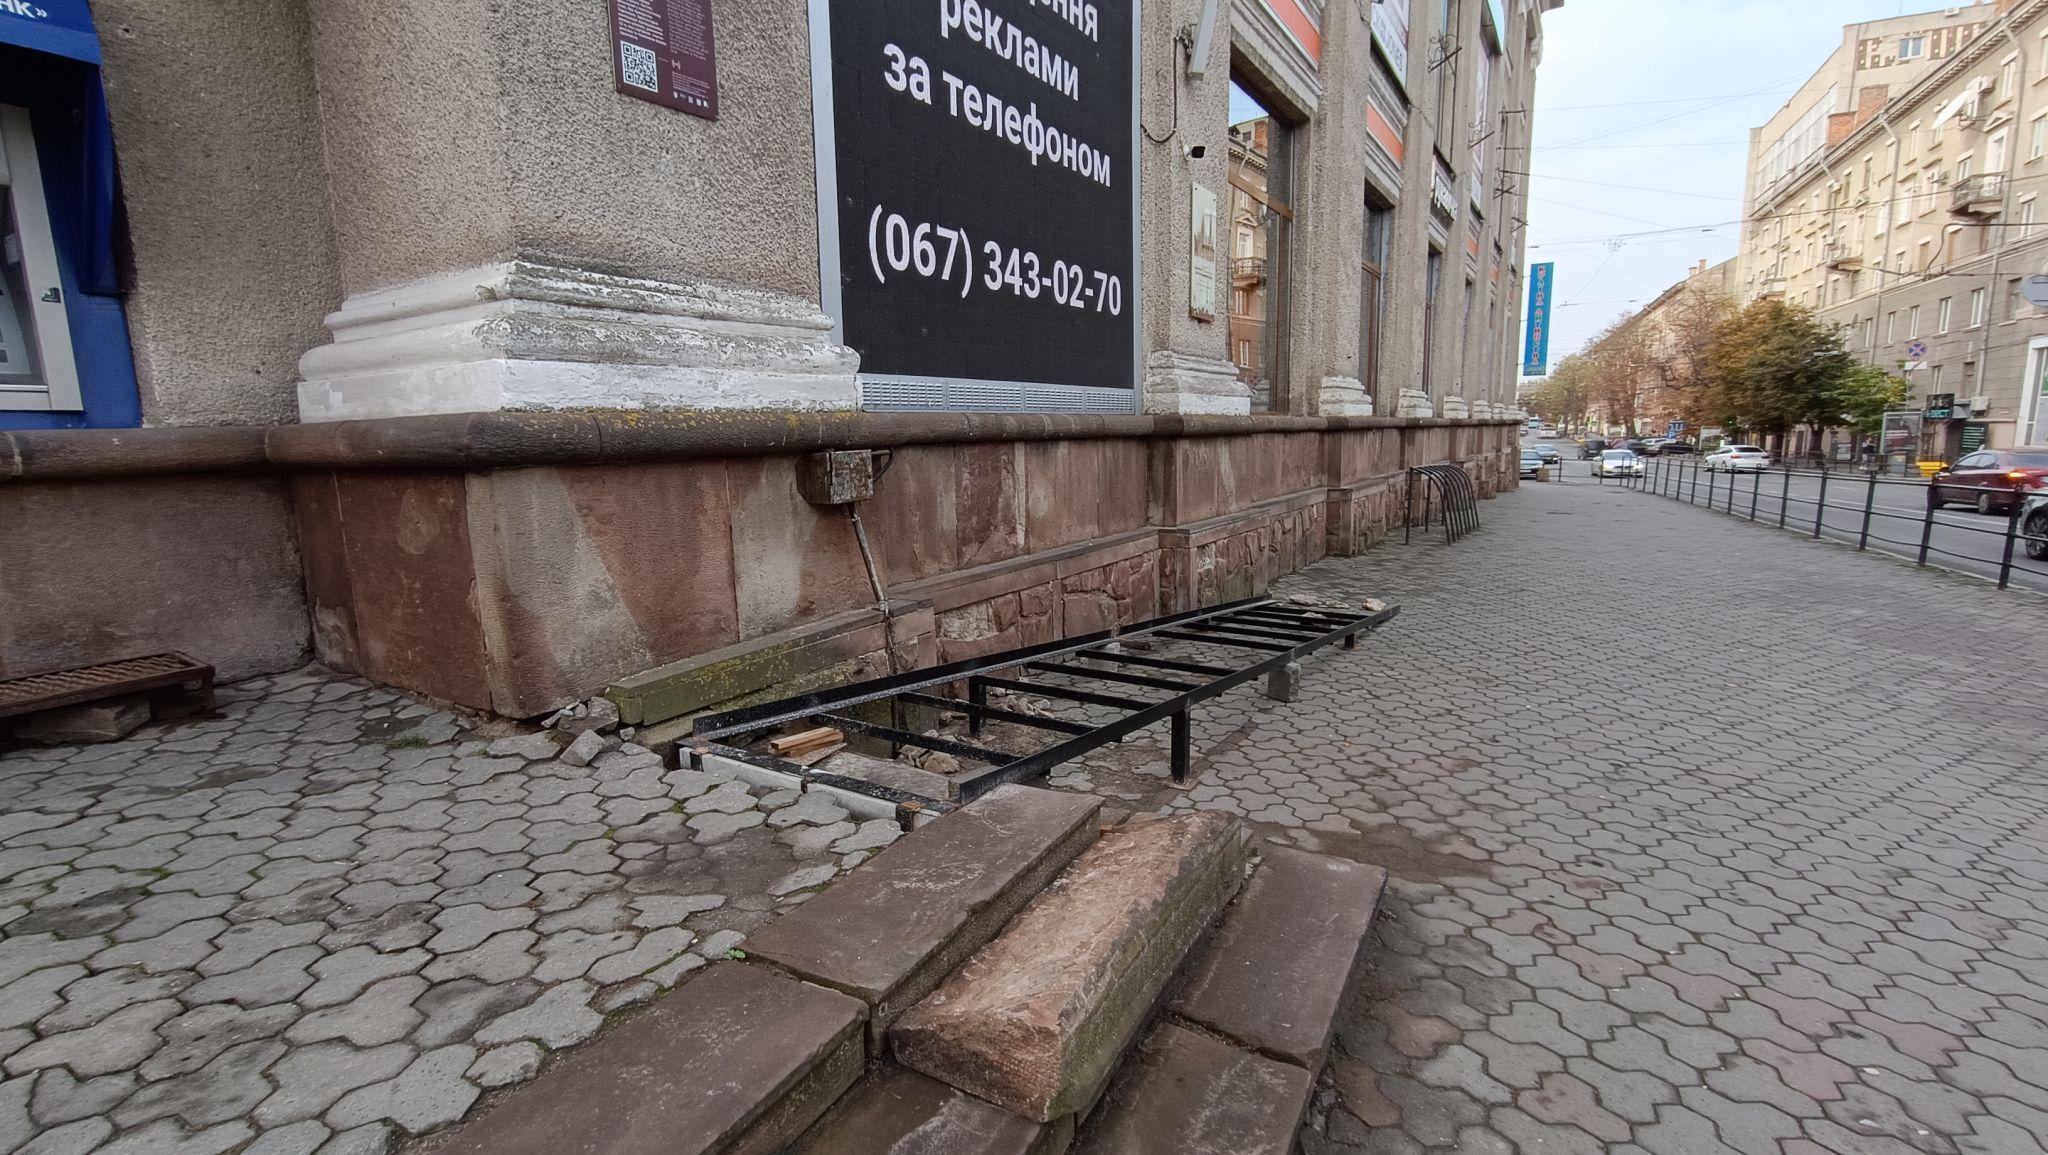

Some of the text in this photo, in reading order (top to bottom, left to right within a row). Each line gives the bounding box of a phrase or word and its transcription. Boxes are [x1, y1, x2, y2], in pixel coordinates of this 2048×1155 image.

[941, 0, 1079, 101] реклами
[884, 43, 1111, 187] за телефоном
[869, 204, 1122, 316] (067) 343-02-70
